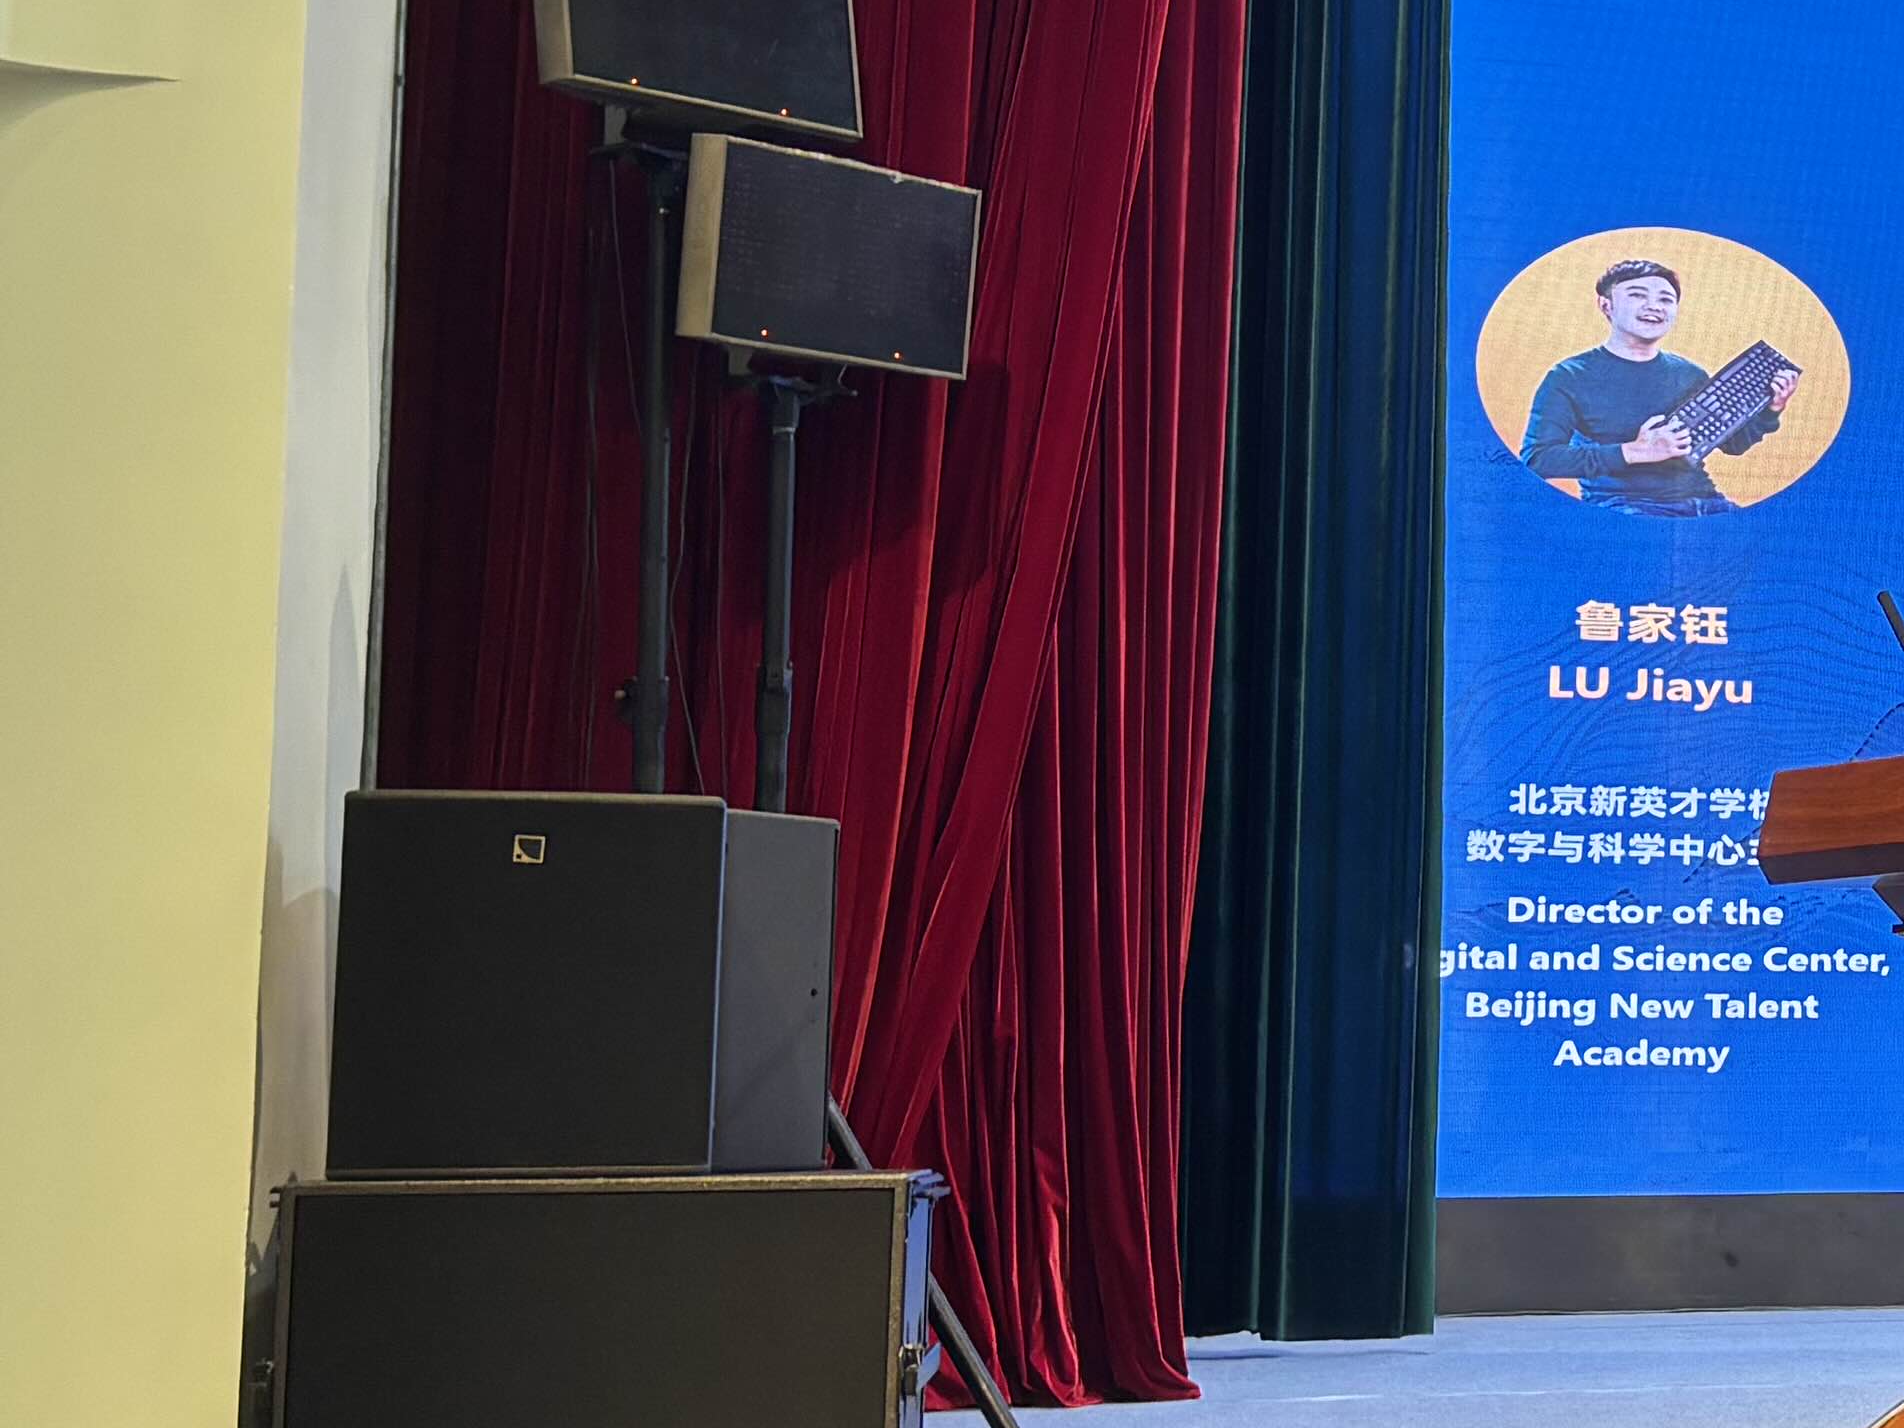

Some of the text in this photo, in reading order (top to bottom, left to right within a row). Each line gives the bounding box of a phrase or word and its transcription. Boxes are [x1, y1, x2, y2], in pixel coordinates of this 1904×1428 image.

[1575, 599, 1729, 646] 鲁家钰
[1548, 665, 1754, 712] LU Jiayu
[1507, 895, 1784, 926] Director of the
[1529, 943, 1601, 972] and
[1612, 945, 1753, 973] Science
[1763, 946, 1890, 977] Center,
[1465, 991, 1820, 1027] Beijing New Talent
[1553, 1039, 1731, 1074] Academy
